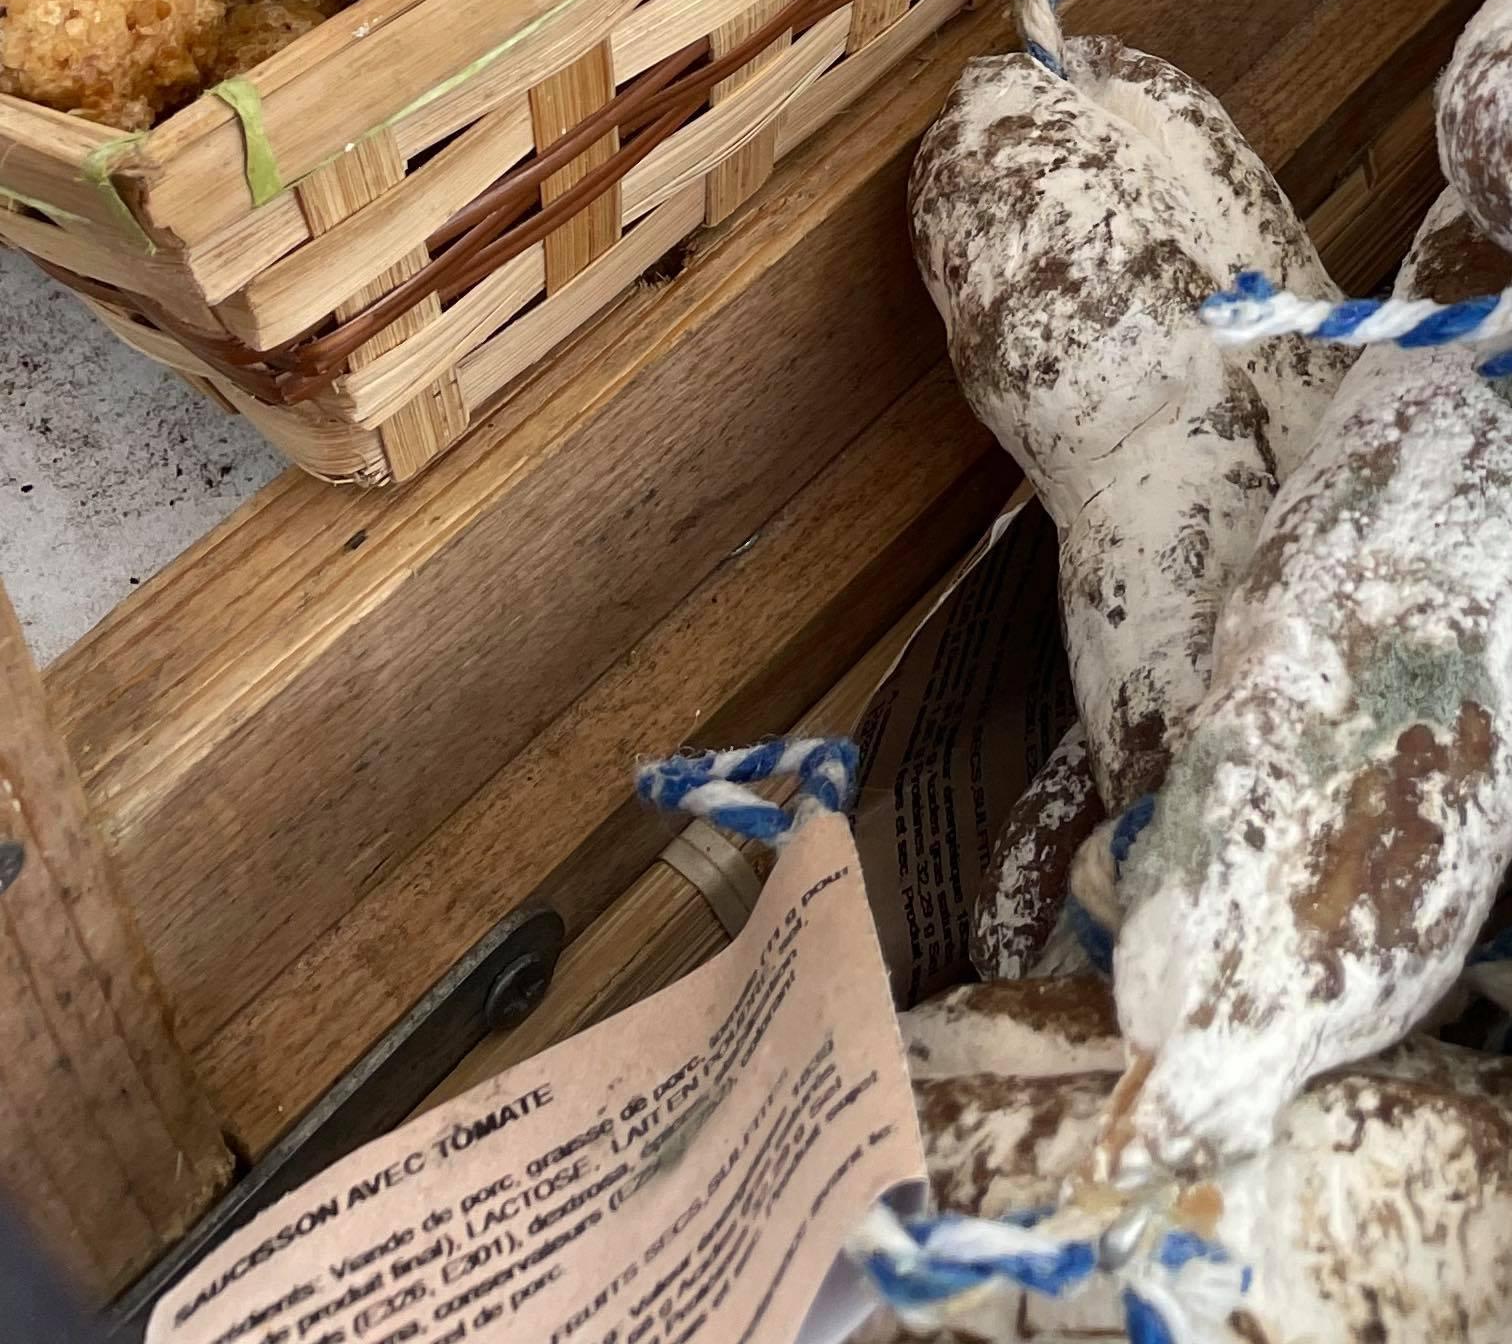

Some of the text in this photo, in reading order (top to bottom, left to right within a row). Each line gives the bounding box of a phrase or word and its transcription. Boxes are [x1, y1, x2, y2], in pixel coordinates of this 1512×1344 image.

[175, 1198, 339, 1321] SAUCISSON
[346, 1152, 424, 1208] AVEC
[296, 1075, 700, 1337] produit final), LACTOSE, LAIT EN
[329, 1228, 414, 1280] Viande
[421, 1208, 452, 1232] de
[460, 1175, 513, 1214] porc,
[619, 1096, 647, 1121] de
[652, 1055, 710, 1102] porc,
[430, 1209, 602, 1320] conservateurs
[472, 1304, 502, 1328] de
